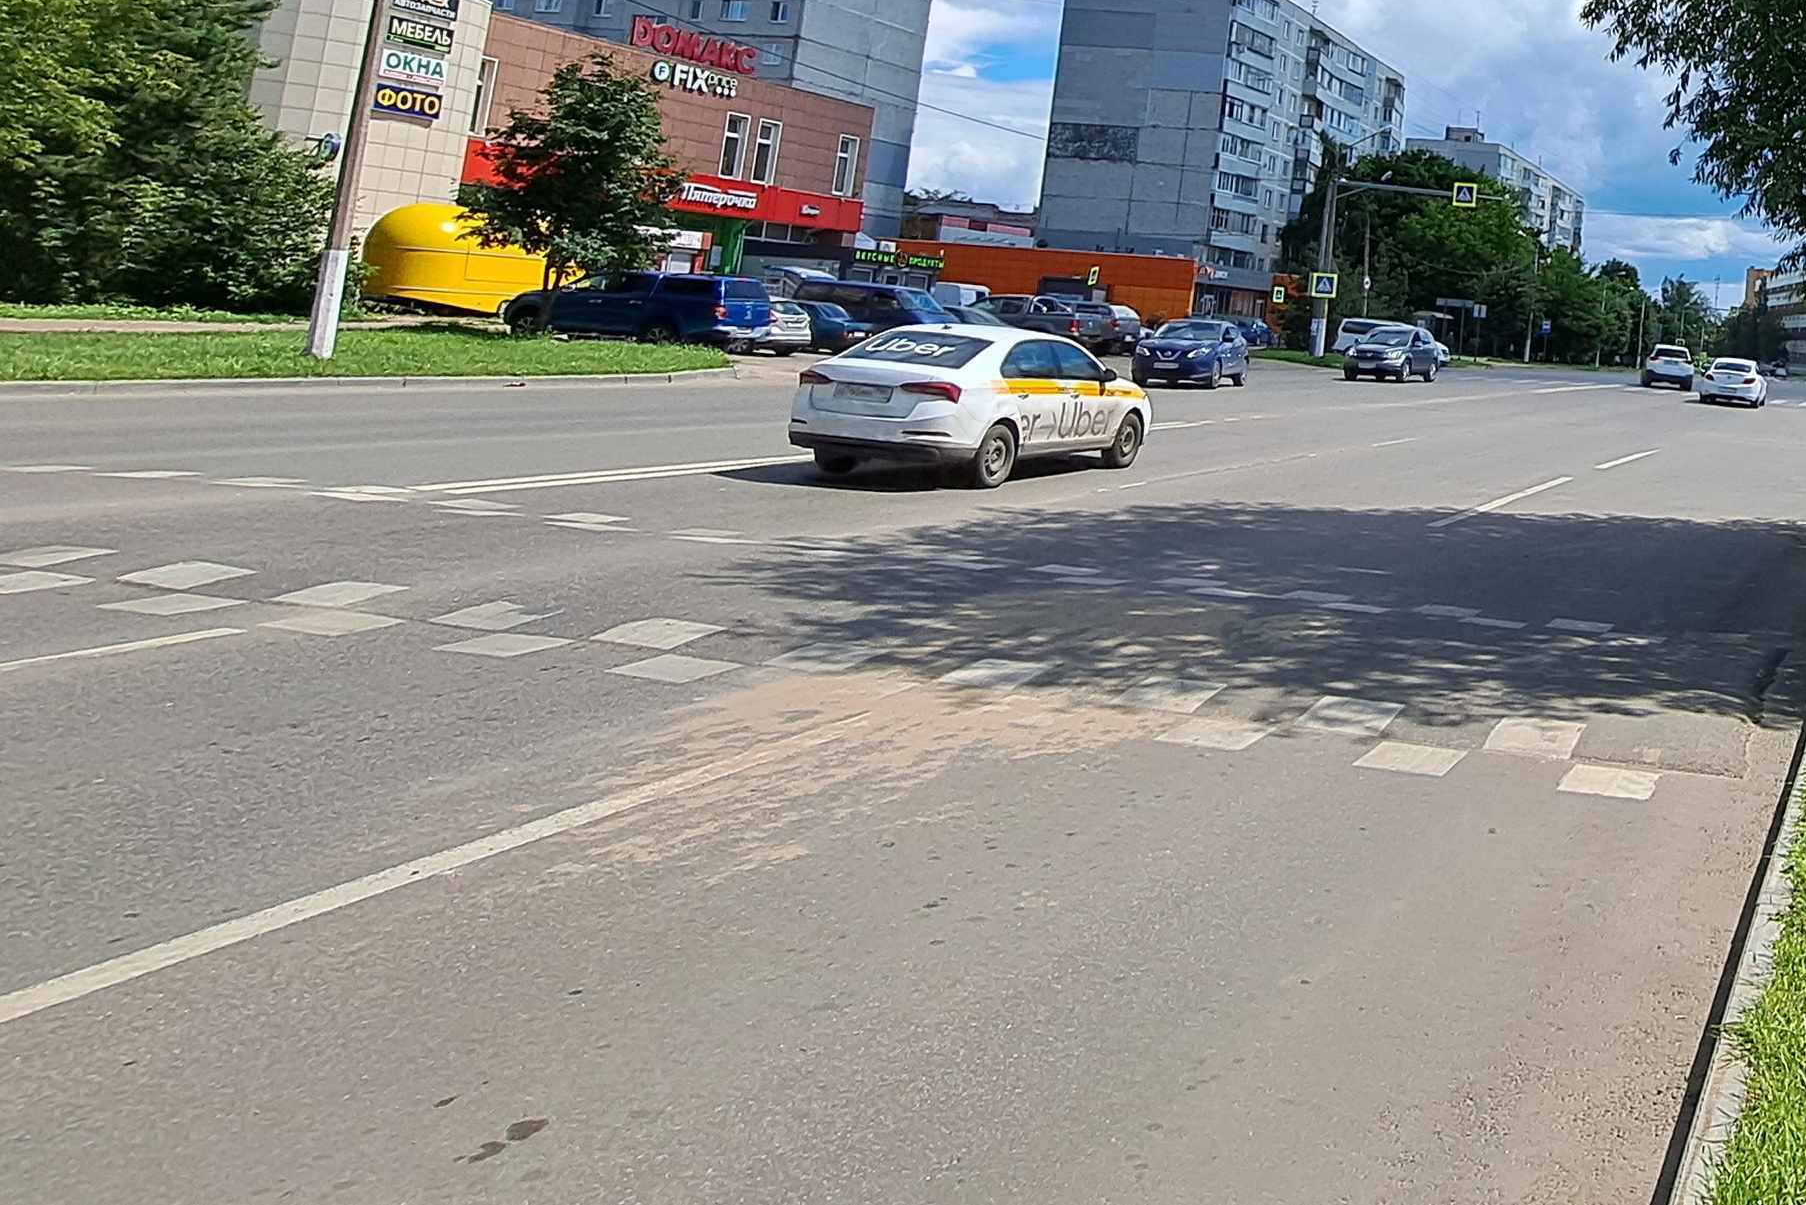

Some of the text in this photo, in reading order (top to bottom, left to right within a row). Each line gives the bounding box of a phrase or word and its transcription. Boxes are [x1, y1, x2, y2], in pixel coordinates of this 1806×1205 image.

[391, 18, 451, 45] МЕБЕЛЬ
[386, 53, 444, 78] ОКНА
[673, 63, 709, 92] FIX
[708, 72, 738, 90] price
[377, 88, 440, 115] ФОТО
[865, 337, 956, 357] Uber
[1058, 401, 1114, 439] Uber
